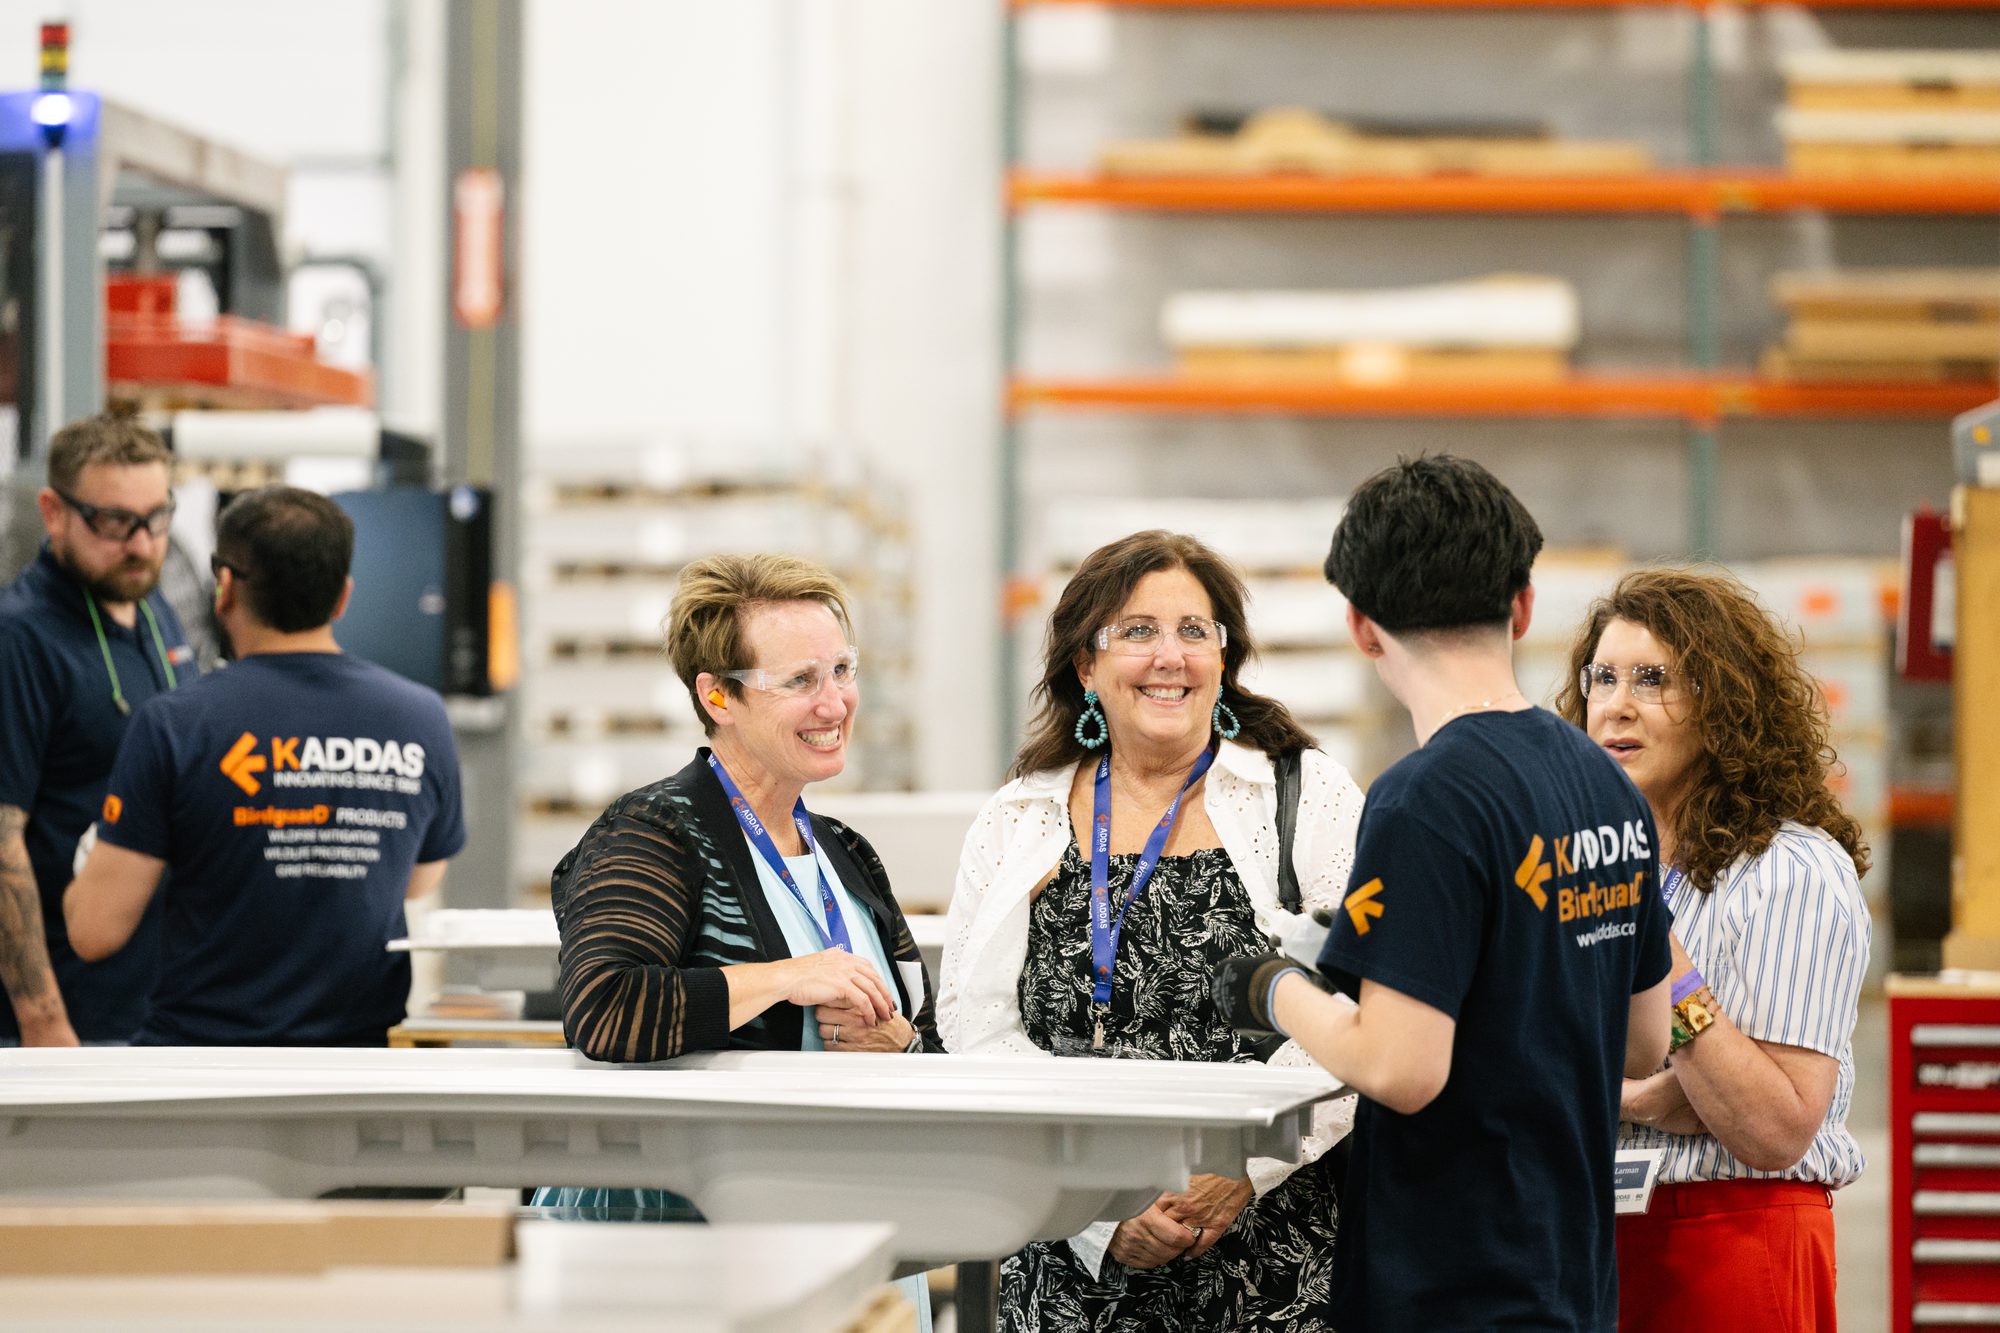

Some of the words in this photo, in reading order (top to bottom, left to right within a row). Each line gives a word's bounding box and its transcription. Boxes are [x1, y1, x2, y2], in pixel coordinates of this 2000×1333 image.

[272, 736, 425, 778] KADDAS
[273, 771, 355, 789] INNOVATING
[356, 772, 395, 792] SINCE
[336, 807, 408, 830] PRODUCTS
[1663, 870, 1682, 901] ADDAS
